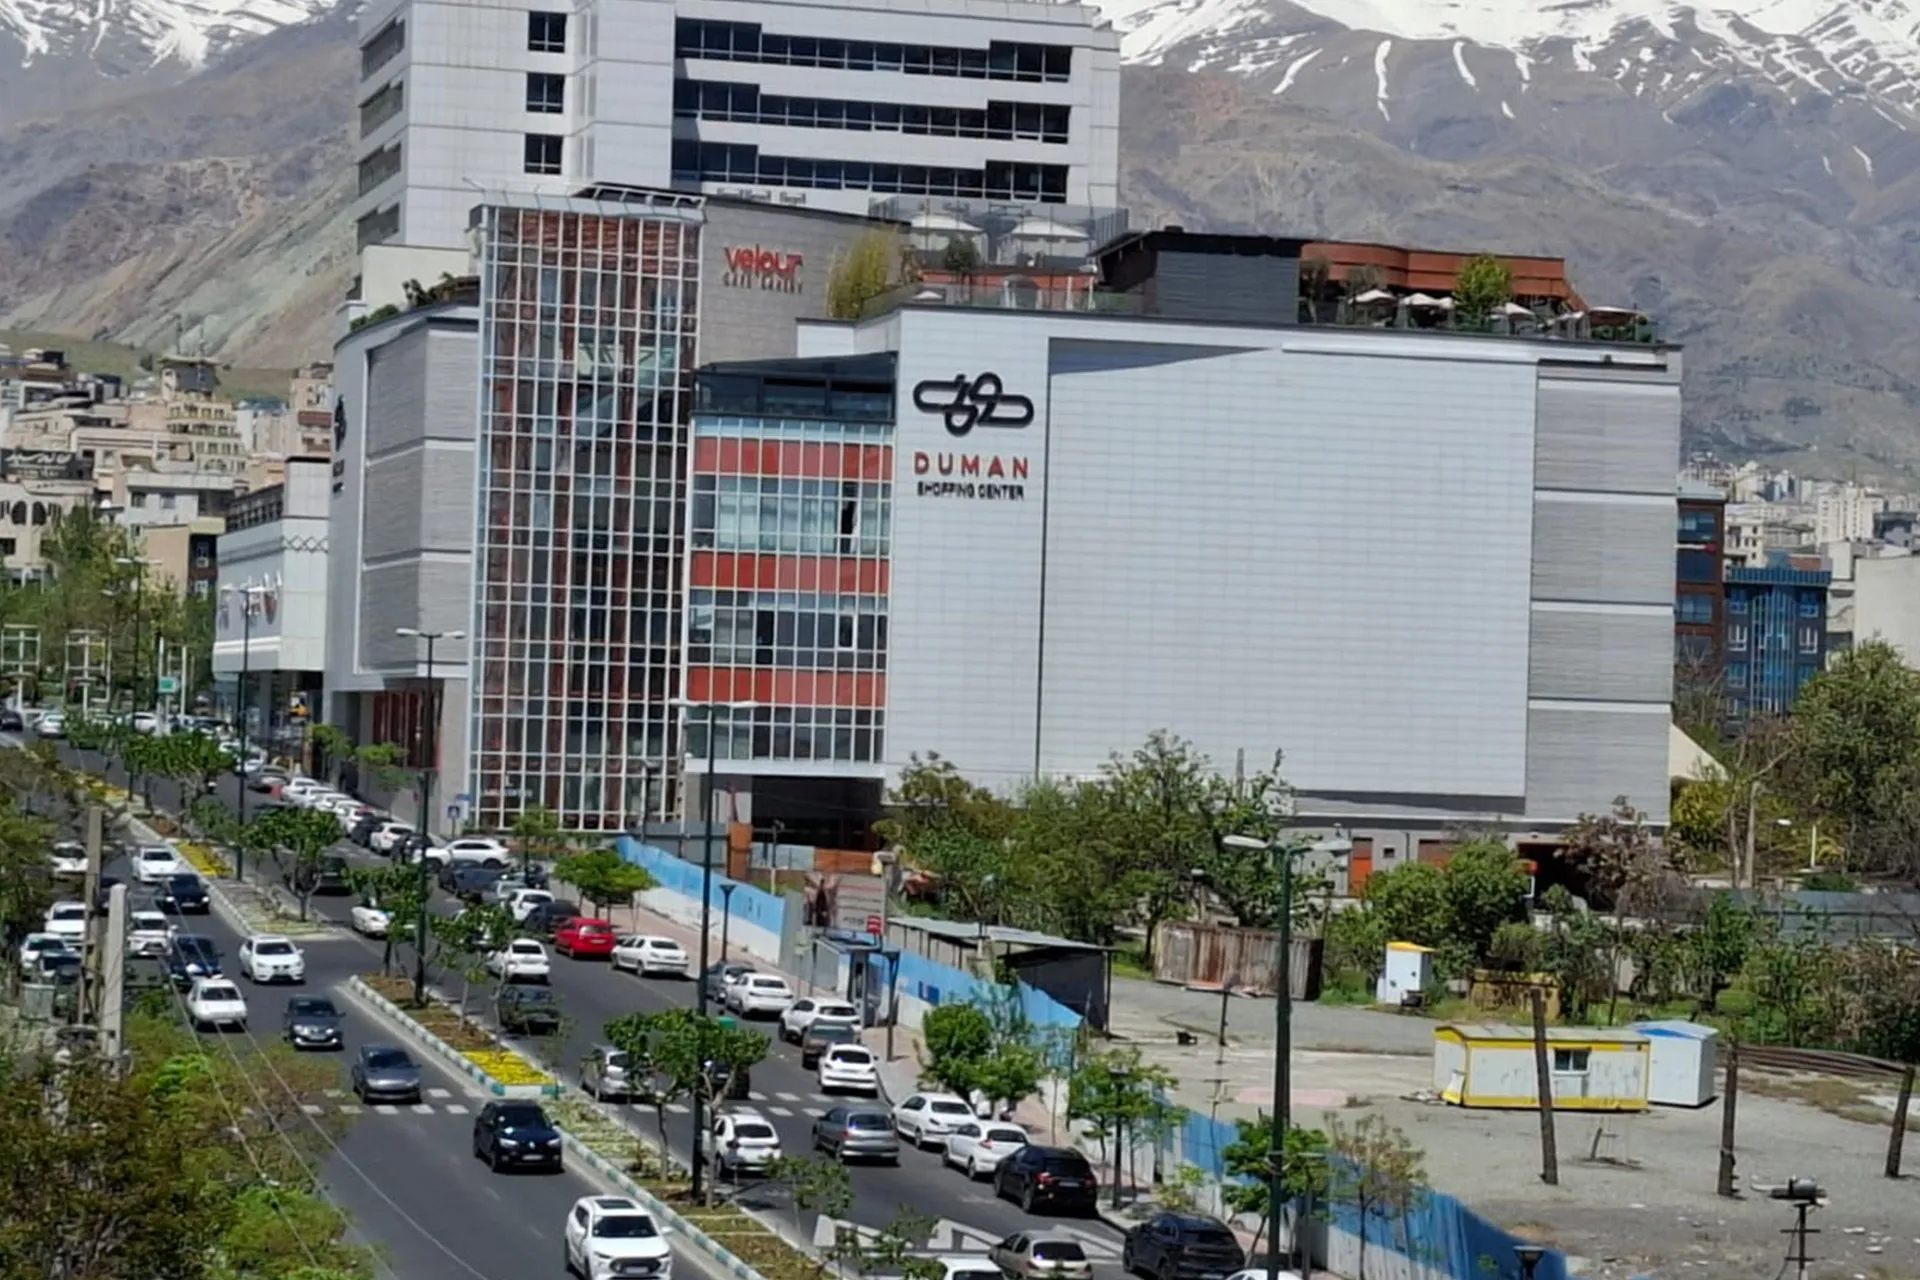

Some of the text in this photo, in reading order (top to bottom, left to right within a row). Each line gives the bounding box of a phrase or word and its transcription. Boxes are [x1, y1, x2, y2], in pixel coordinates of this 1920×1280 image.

[914, 452, 1028, 480] DUMAN
[917, 481, 1024, 501] SHOPPING CENTER
